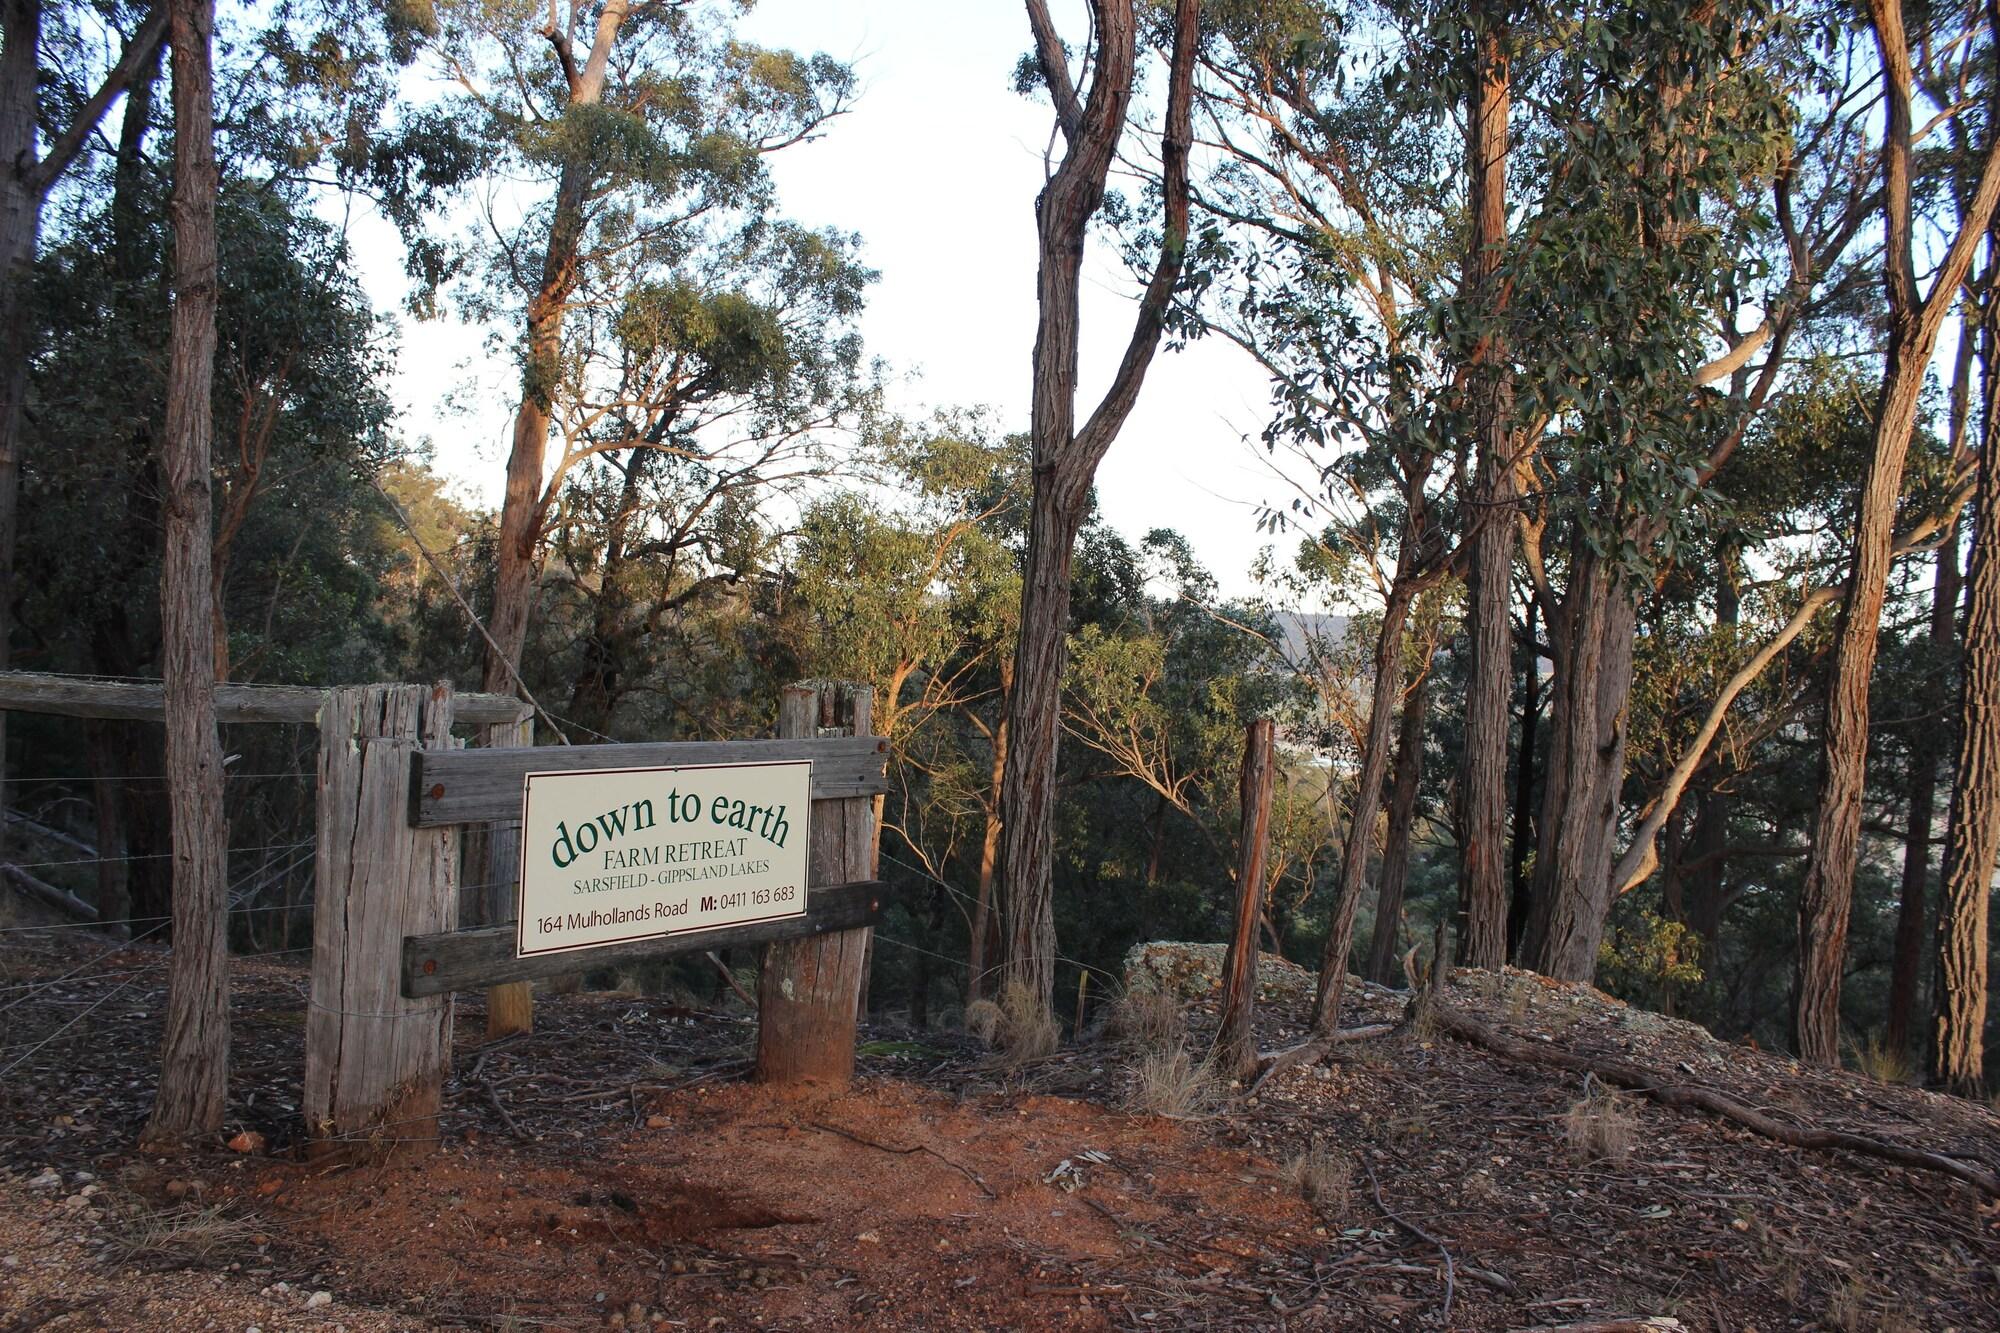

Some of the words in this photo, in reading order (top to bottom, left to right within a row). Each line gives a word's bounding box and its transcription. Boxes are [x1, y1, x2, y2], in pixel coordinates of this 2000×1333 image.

[552, 799, 656, 868] down
[668, 787, 701, 823] to
[711, 795, 789, 849] earth
[604, 845, 660, 869] FARM
[665, 838, 748, 863] RETREAT
[573, 872, 648, 895] SARSFIELD
[658, 864, 728, 885] GIPPSLAND
[730, 860, 770, 877] LAKES
[537, 916, 563, 934] 164
[567, 904, 650, 930] Mulhollands
[654, 898, 688, 918] Road
[700, 895, 717, 912] M:
[720, 892, 746, 910] 0411
[752, 889, 770, 905] 163
[774, 886, 795, 902] 683
